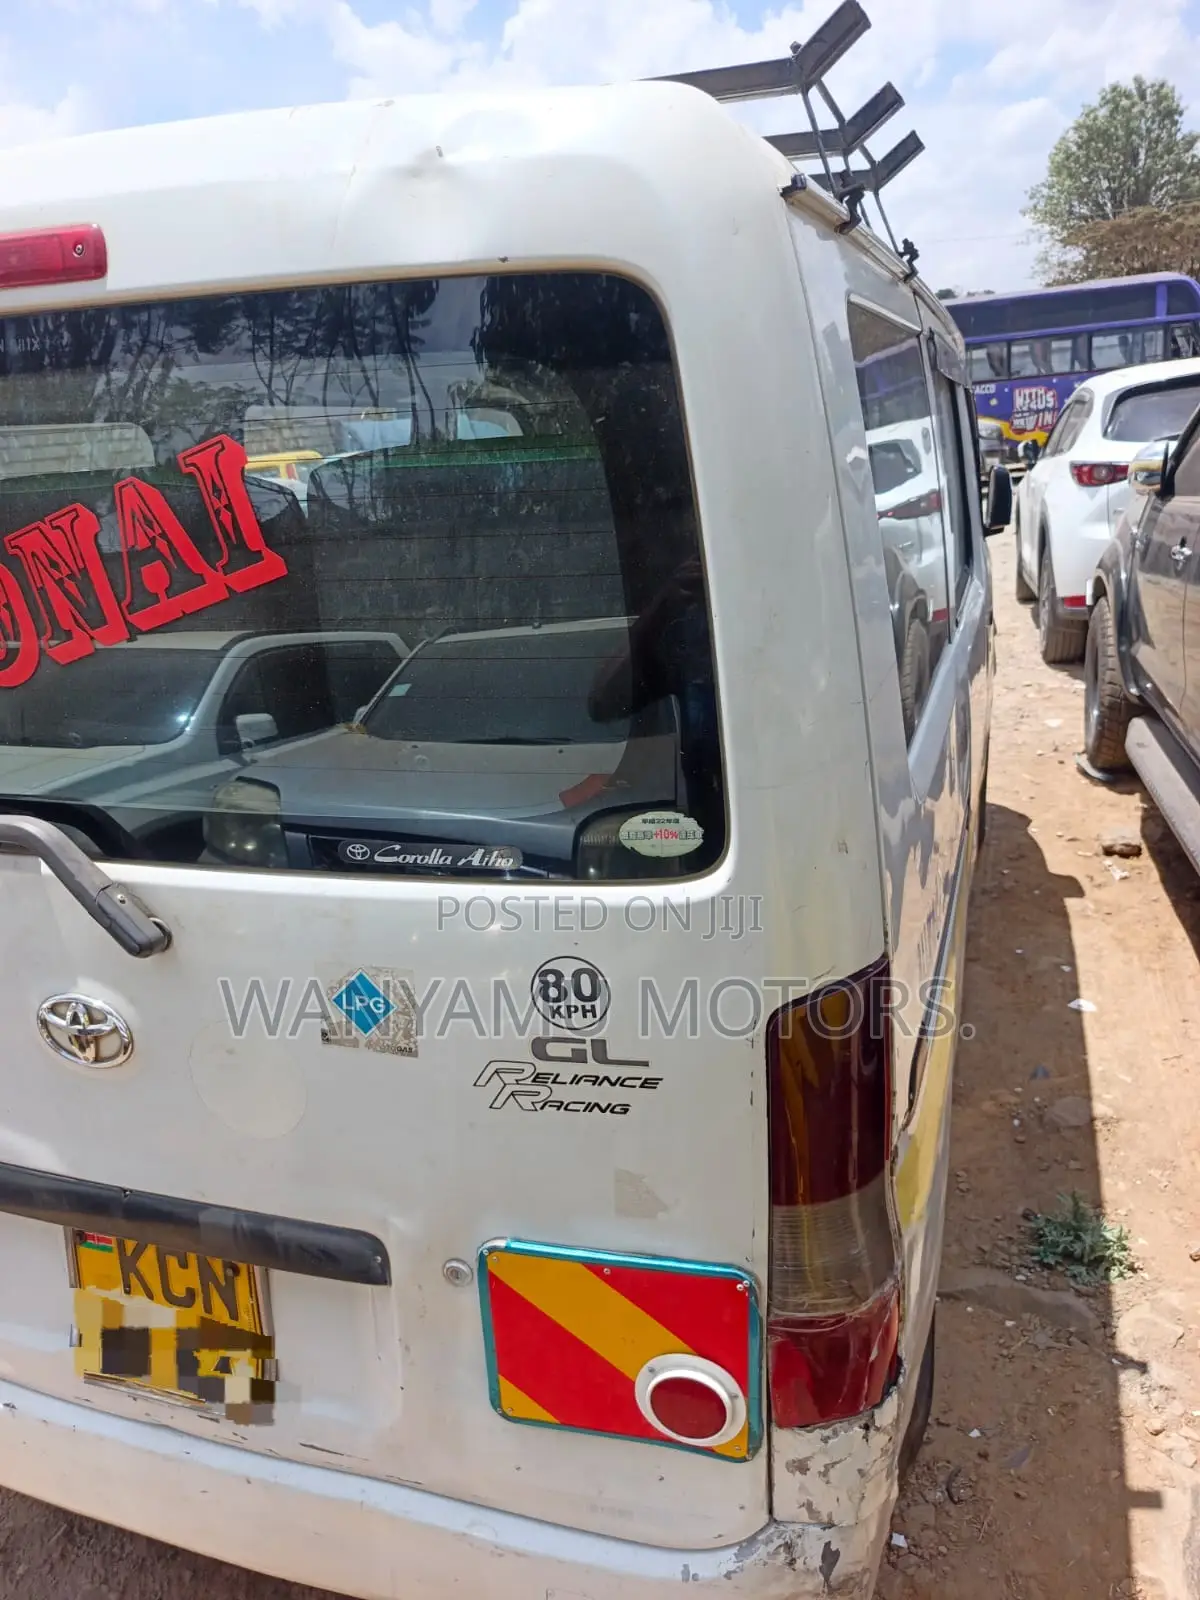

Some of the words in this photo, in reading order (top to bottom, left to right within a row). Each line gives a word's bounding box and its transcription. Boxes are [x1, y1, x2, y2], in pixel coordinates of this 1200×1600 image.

[374, 844, 452, 865] Corolla
[537, 967, 601, 1003] 80
[342, 990, 386, 1014] LPG
[548, 1004, 597, 1019] KPH
[530, 1036, 650, 1067] GL
[473, 1060, 664, 1090] RELIANCE
[489, 1083, 632, 1115] RACING
[116, 1237, 239, 1321] KCN
